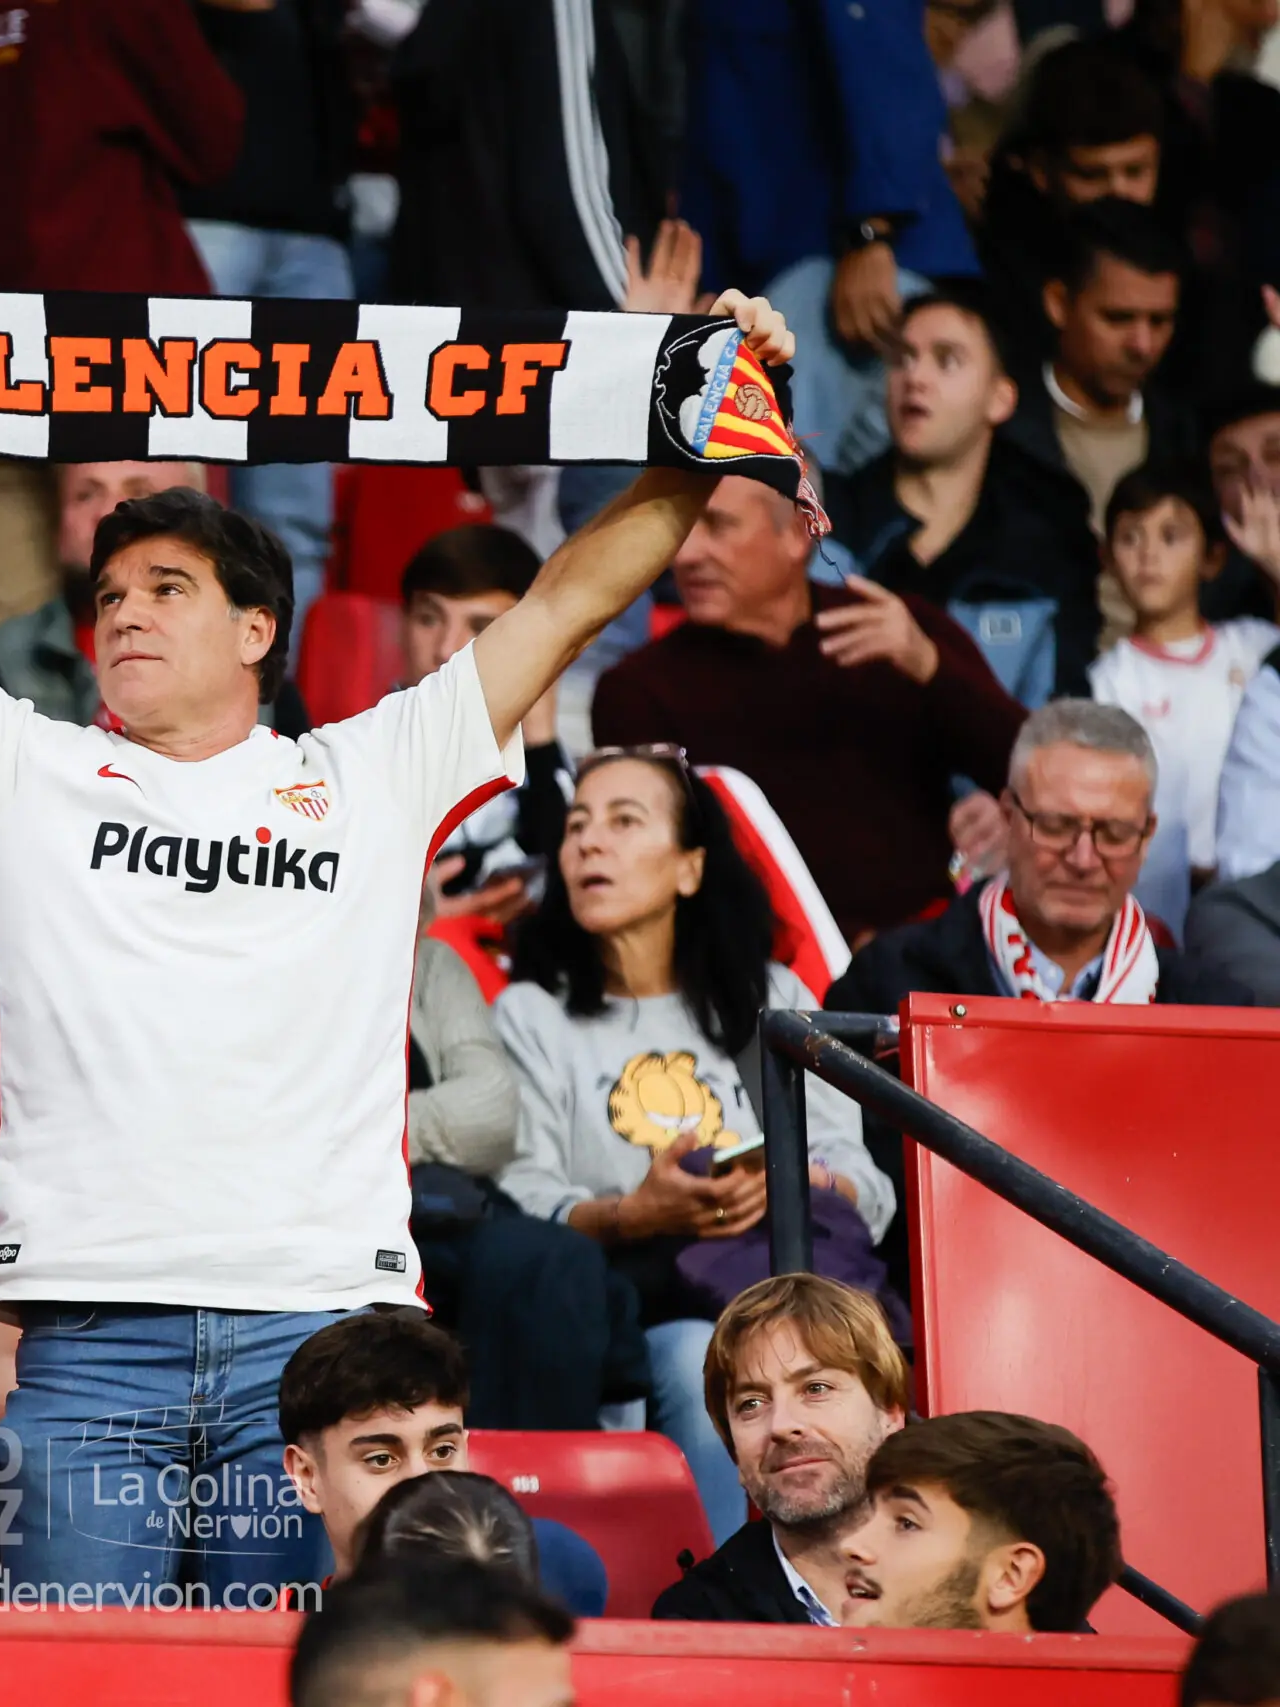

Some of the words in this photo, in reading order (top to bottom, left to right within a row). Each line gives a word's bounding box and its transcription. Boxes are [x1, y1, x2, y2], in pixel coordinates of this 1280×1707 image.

[426, 341, 568, 419] CF
[696, 364, 731, 442] VALENCIA
[90, 822, 340, 893] Playtika
